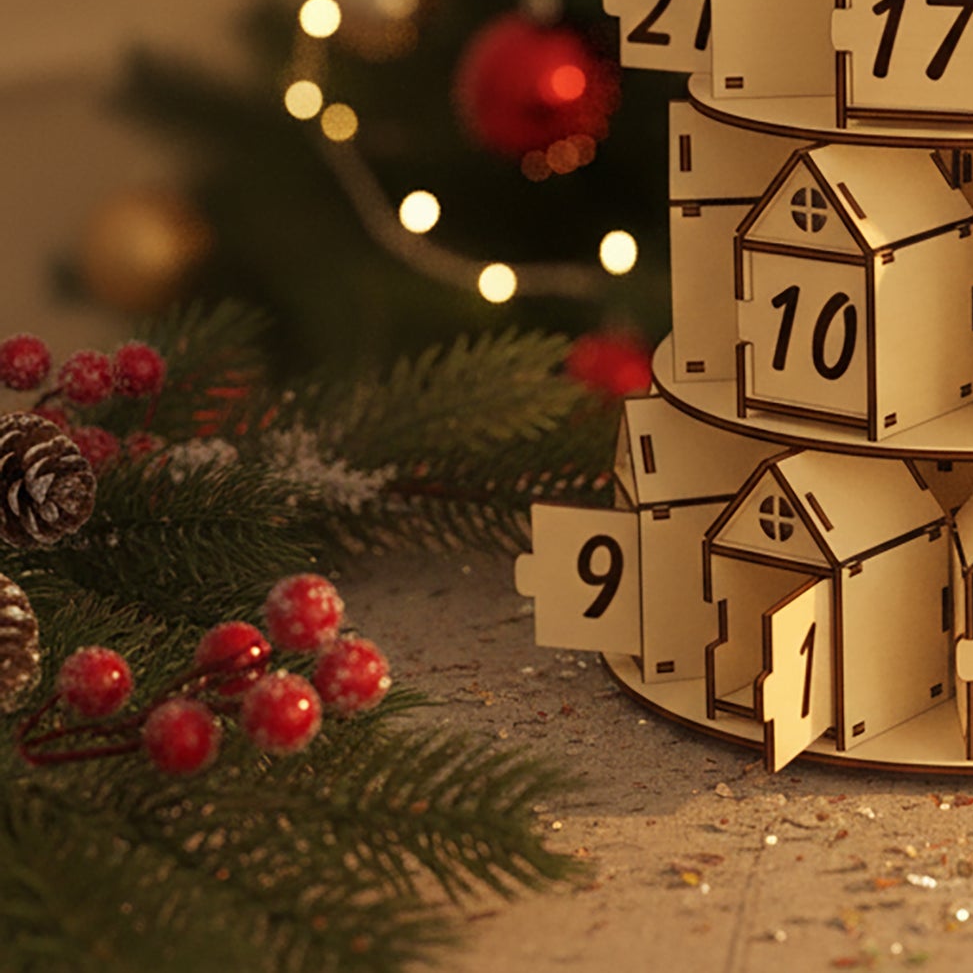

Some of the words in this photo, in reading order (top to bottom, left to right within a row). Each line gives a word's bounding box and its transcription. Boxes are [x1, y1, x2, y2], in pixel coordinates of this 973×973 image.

[770, 284, 858, 381] 10
[576, 533, 625, 620] 9
[799, 621, 818, 720] 1
